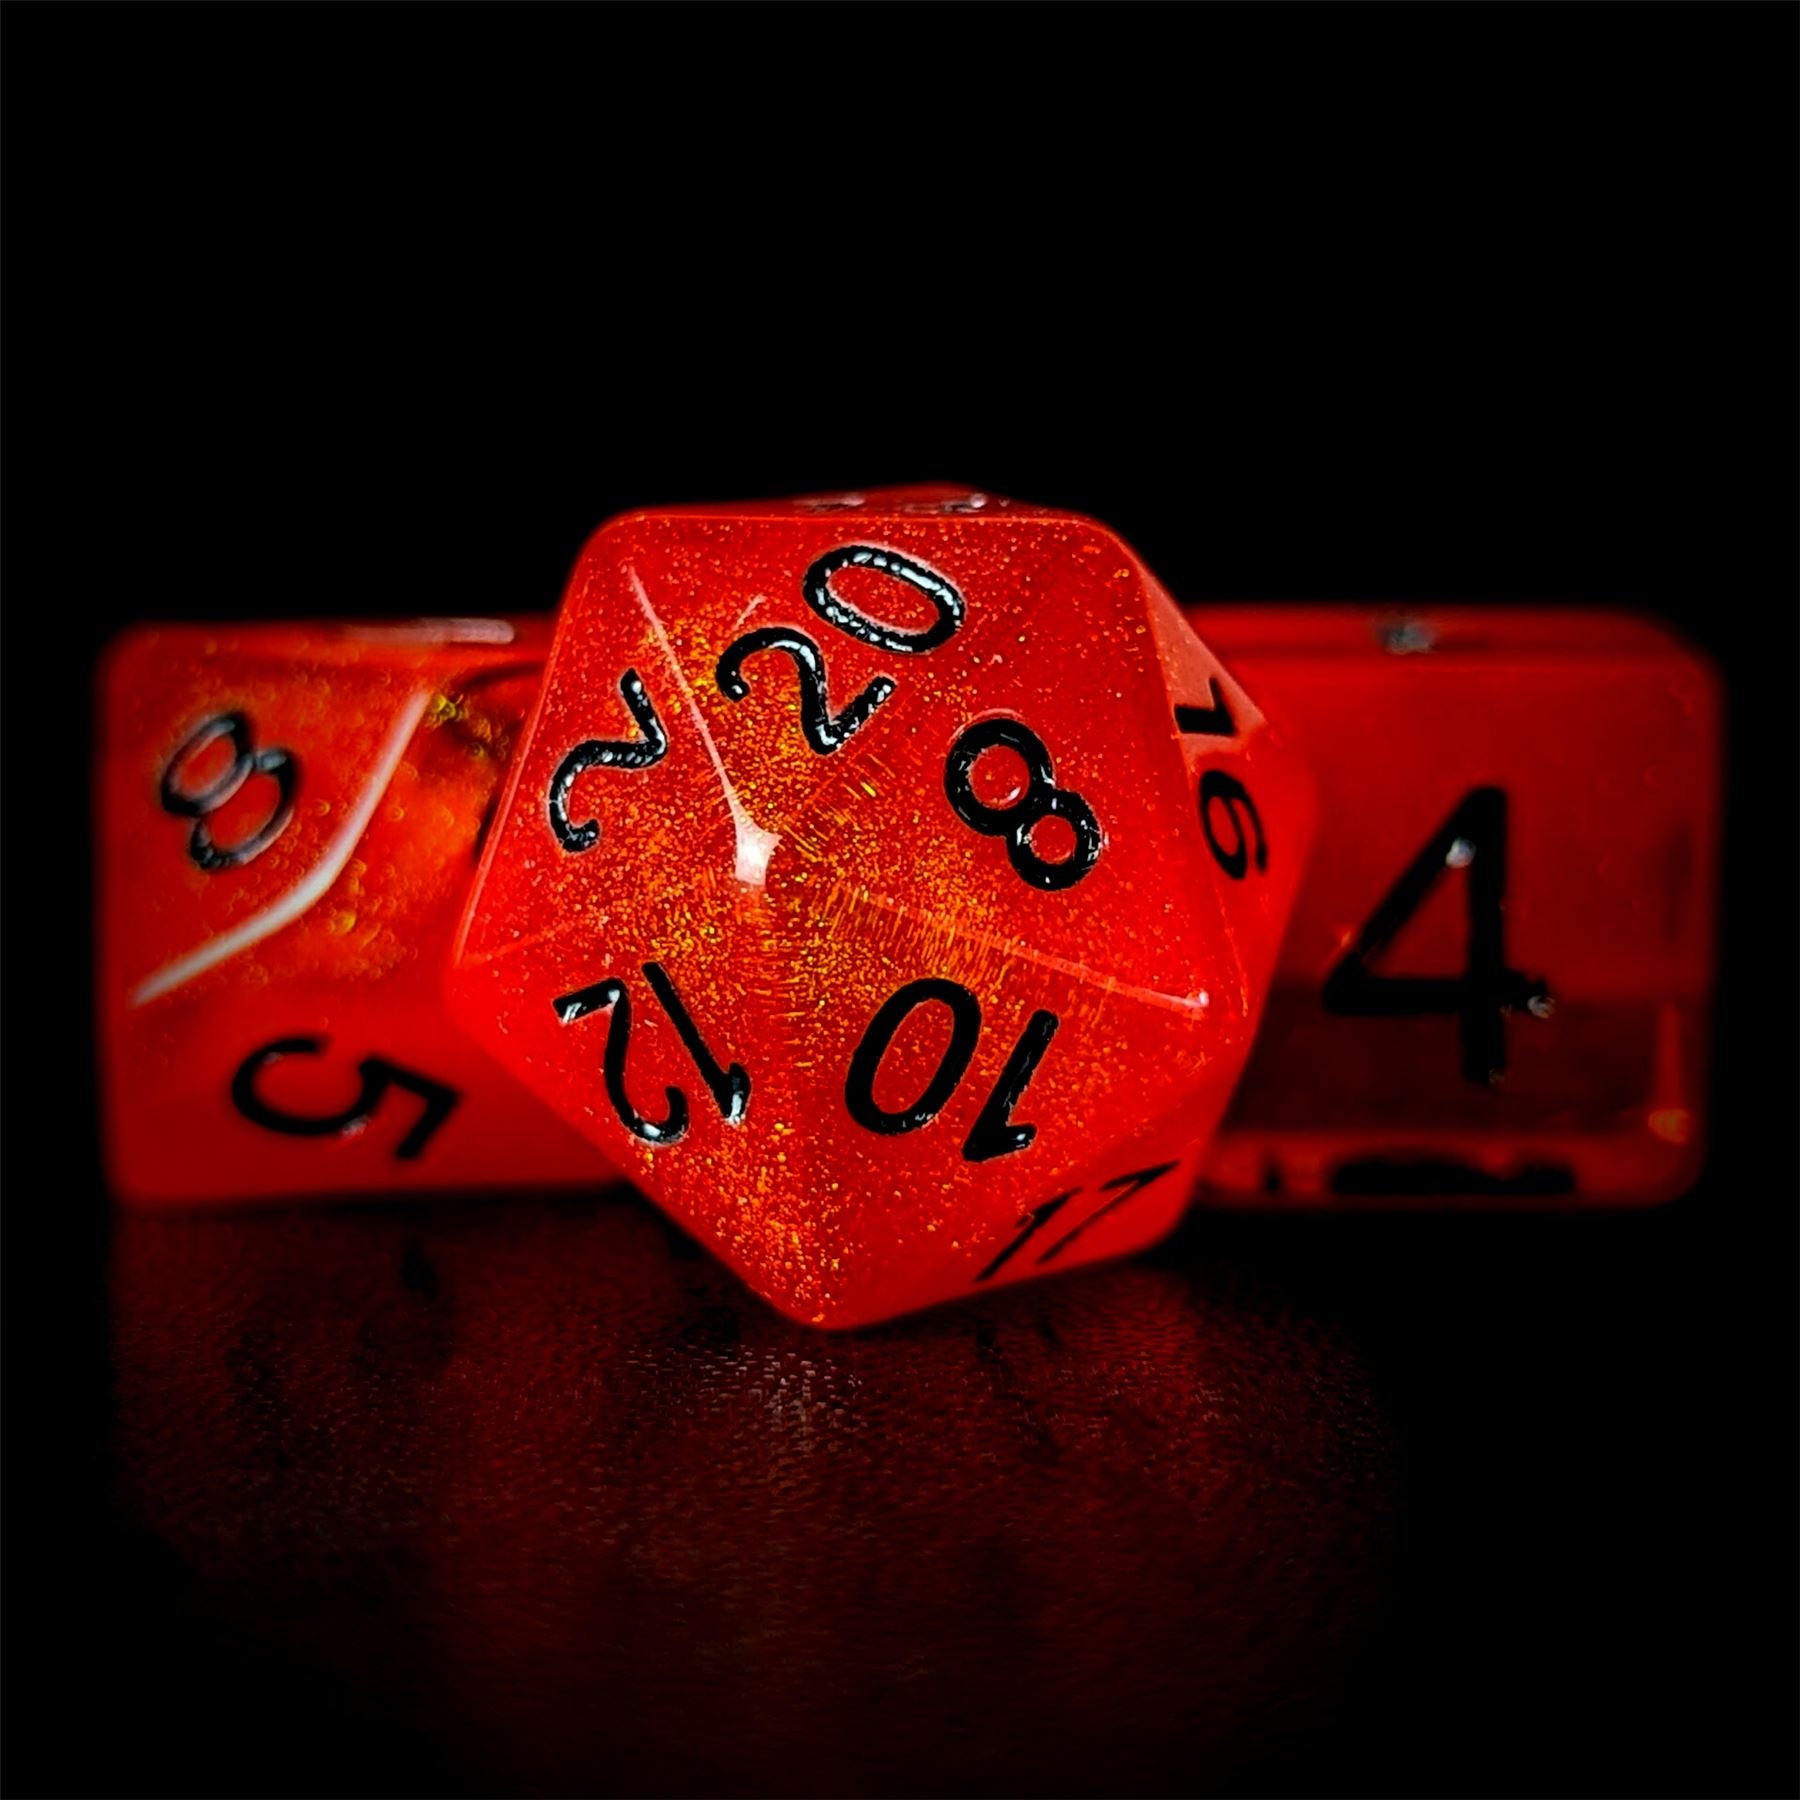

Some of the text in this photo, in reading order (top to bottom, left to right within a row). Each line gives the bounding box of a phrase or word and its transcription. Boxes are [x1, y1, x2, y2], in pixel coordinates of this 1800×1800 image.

[716, 544, 965, 755] 20
[159, 709, 298, 872] 8
[549, 668, 668, 852] 2
[945, 717, 1102, 890] 8
[1174, 677, 1267, 880] 16
[1323, 786, 1554, 1086] 4
[231, 1036, 464, 1162] 5
[553, 962, 750, 1144] 12
[846, 978, 1059, 1162] 10
